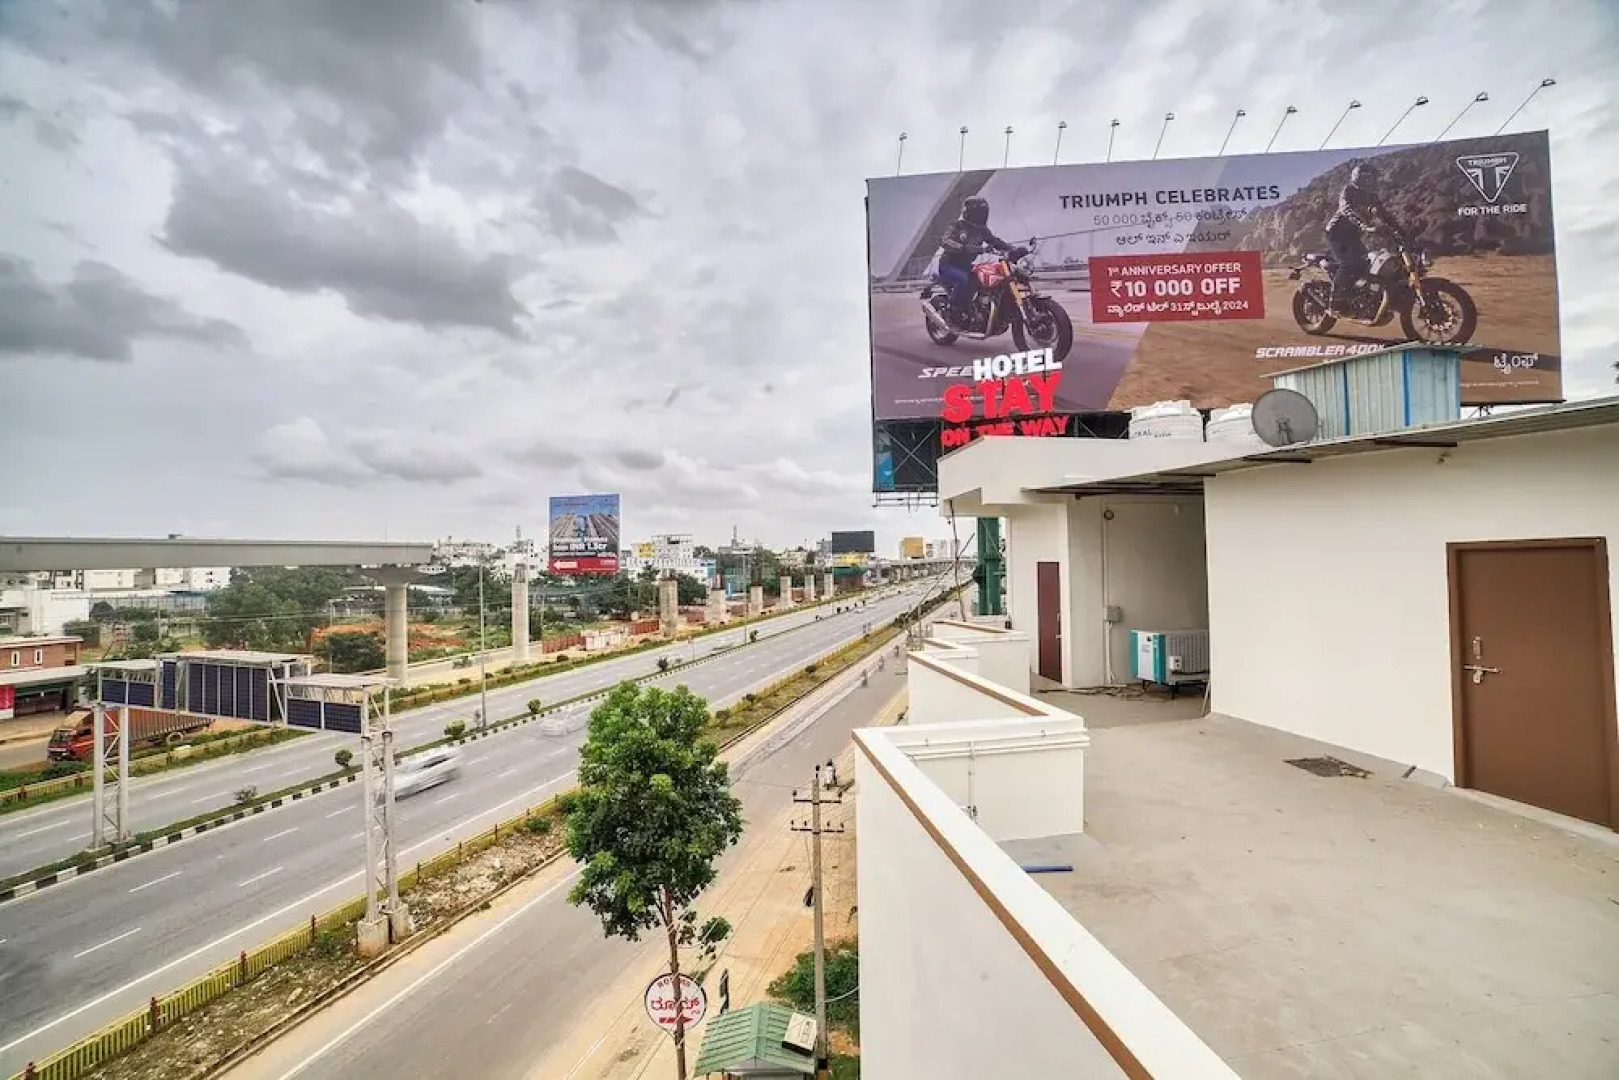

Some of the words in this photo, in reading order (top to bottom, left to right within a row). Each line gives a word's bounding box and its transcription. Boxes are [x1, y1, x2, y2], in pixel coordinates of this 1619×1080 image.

[1059, 191, 1147, 209] TRIUMPH
[1155, 185, 1280, 205] CELEBRATES
[1458, 206, 1478, 216] FOR
[1480, 205, 1500, 215] THE
[1502, 203, 1528, 213] RIDE
[1113, 213, 1137, 225] 000
[1121, 263, 1201, 276] ANNIVERSARY
[1204, 262, 1241, 274] OFFER
[1154, 278, 1193, 297] 000
[1200, 277, 1241, 295] OFF
[1223, 301, 1249, 310] 2024
[1256, 344, 1345, 358] SCRAMBLER
[973, 348, 1062, 382] HOTEL
[918, 366, 974, 379] SPEE
[942, 371, 1062, 424] STAY
[940, 427, 971, 447] ON
[976, 422, 1015, 437] THE
[1020, 416, 1069, 437] WAY
